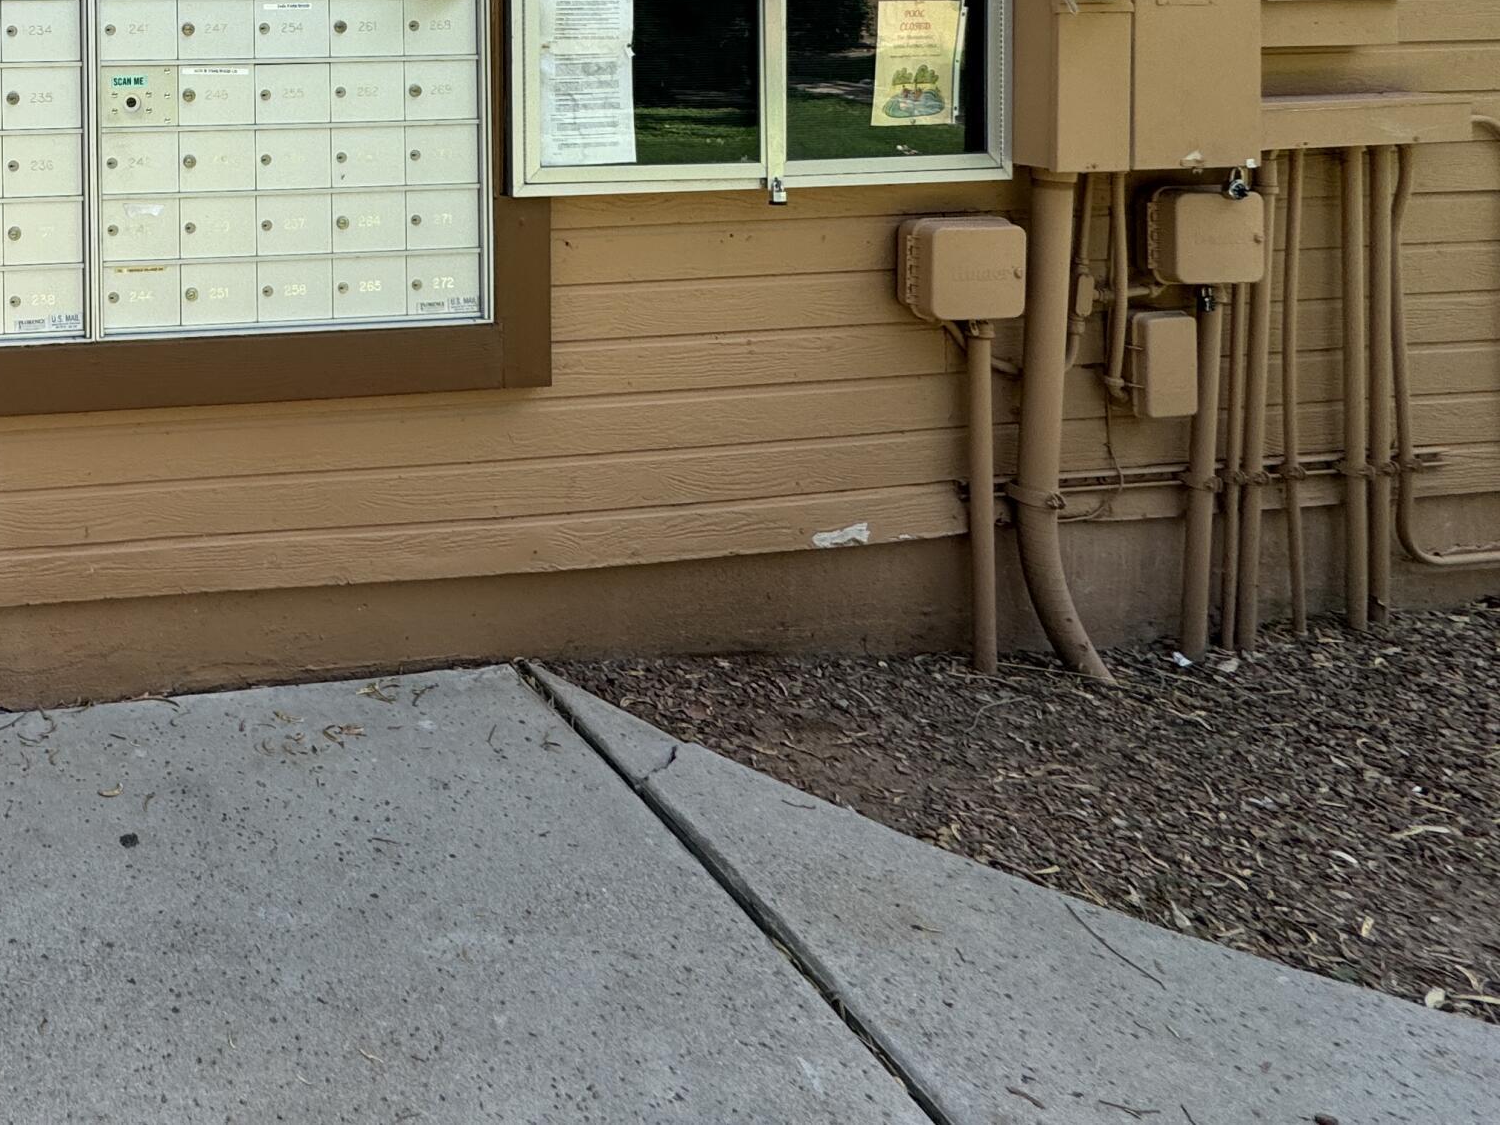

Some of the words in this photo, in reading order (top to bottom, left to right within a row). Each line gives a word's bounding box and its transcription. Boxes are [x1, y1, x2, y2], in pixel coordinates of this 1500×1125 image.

[28, 24, 52, 36] 234
[204, 23, 227, 34] 247
[280, 22, 304, 34] 254
[358, 21, 378, 33] 261
[112, 76, 132, 87] SCAN
[132, 76, 145, 86] ME
[30, 91, 53, 104] 235
[359, 280, 382, 293] 265
[432, 277, 455, 290] 272
[208, 286, 229, 300] 251
[31, 294, 56, 307] 238
[51, 315, 64, 323] U.S.
[65, 314, 80, 322] MAIL
